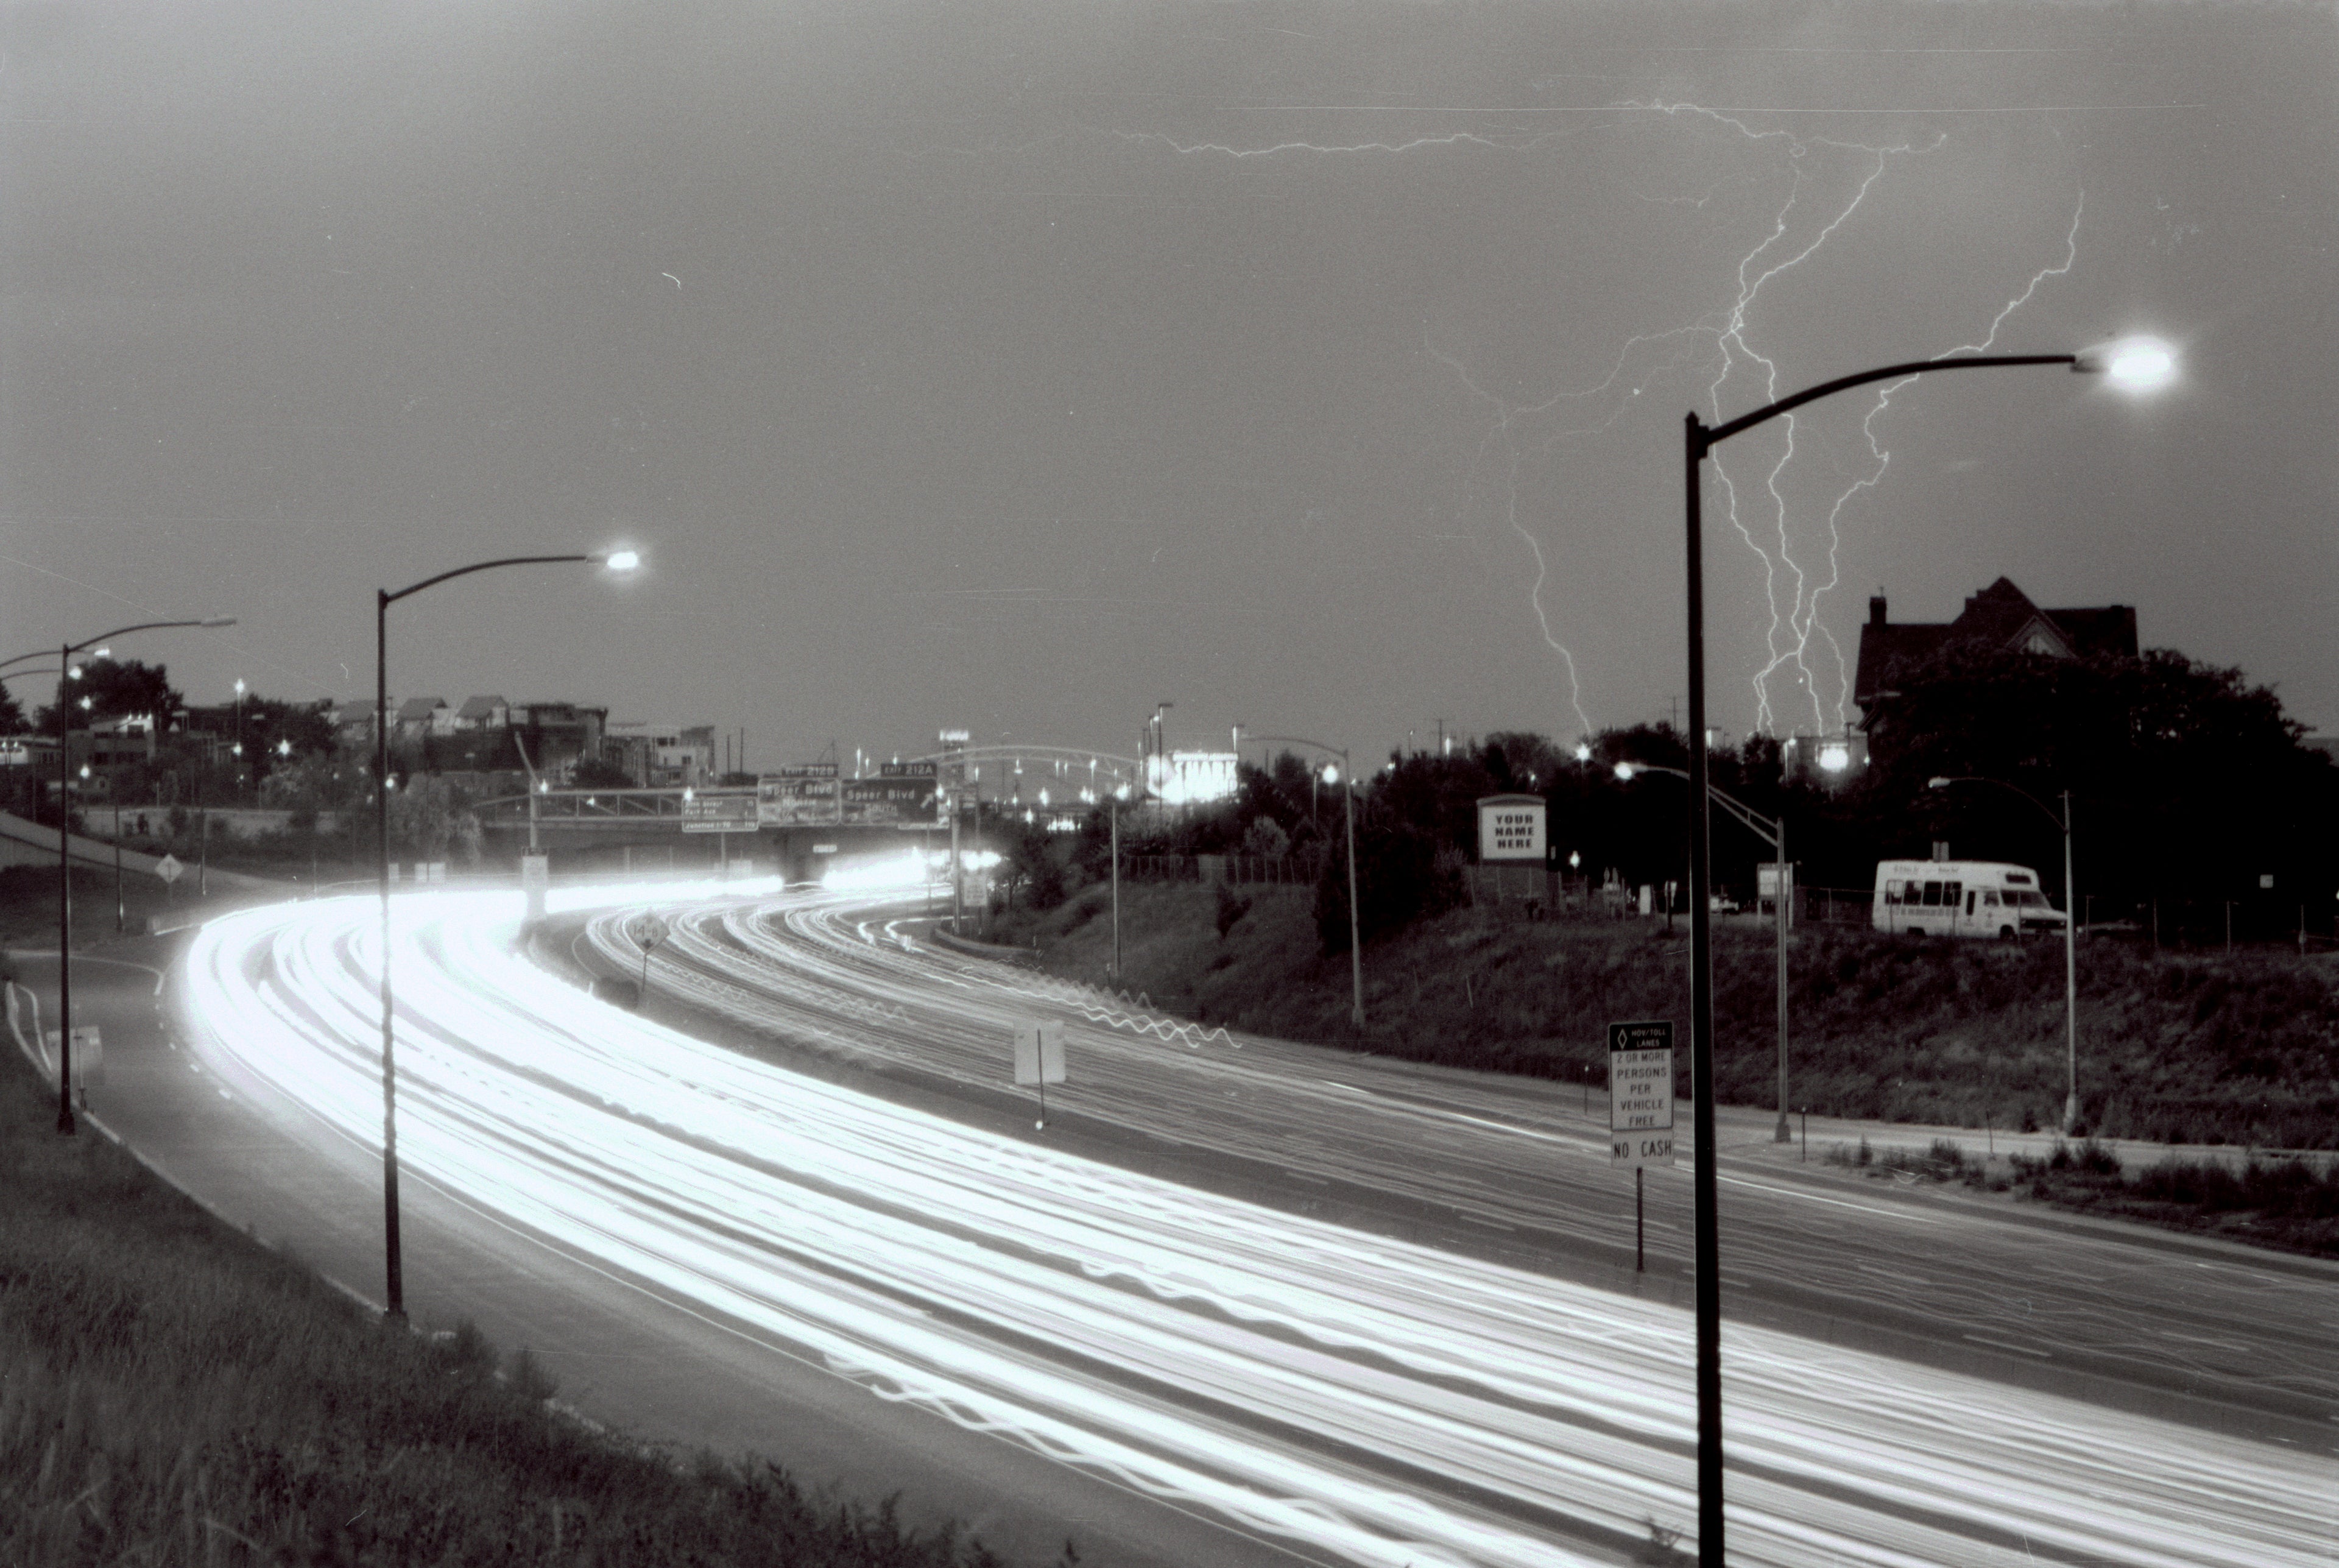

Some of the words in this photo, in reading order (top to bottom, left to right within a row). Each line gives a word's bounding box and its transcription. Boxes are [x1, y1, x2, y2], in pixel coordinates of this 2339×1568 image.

[906, 765, 934, 775] 212A
[765, 784, 800, 796] Speer
[805, 783, 833, 795] Blvd
[847, 789, 881, 802] Speer
[887, 788, 915, 800] Blvd
[1496, 814, 1533, 824] YOUR
[1495, 827, 1534, 836] NAME
[1497, 838, 1532, 849] HERE
[1631, 1028, 1667, 1037] HOV/TOLL
[1636, 1038, 1660, 1048] LANES
[1617, 1052, 1623, 1063] 2
[1626, 1052, 1639, 1063] OR
[1641, 1051, 1667, 1062] MORE
[1617, 1067, 1667, 1079] PERSONS
[1630, 1084, 1651, 1095] PER
[1620, 1098, 1663, 1110] VEHICLE
[1629, 1115, 1655, 1127] FREE
[1614, 1142, 1629, 1159] NO
[1641, 1139, 1671, 1157] CASH
